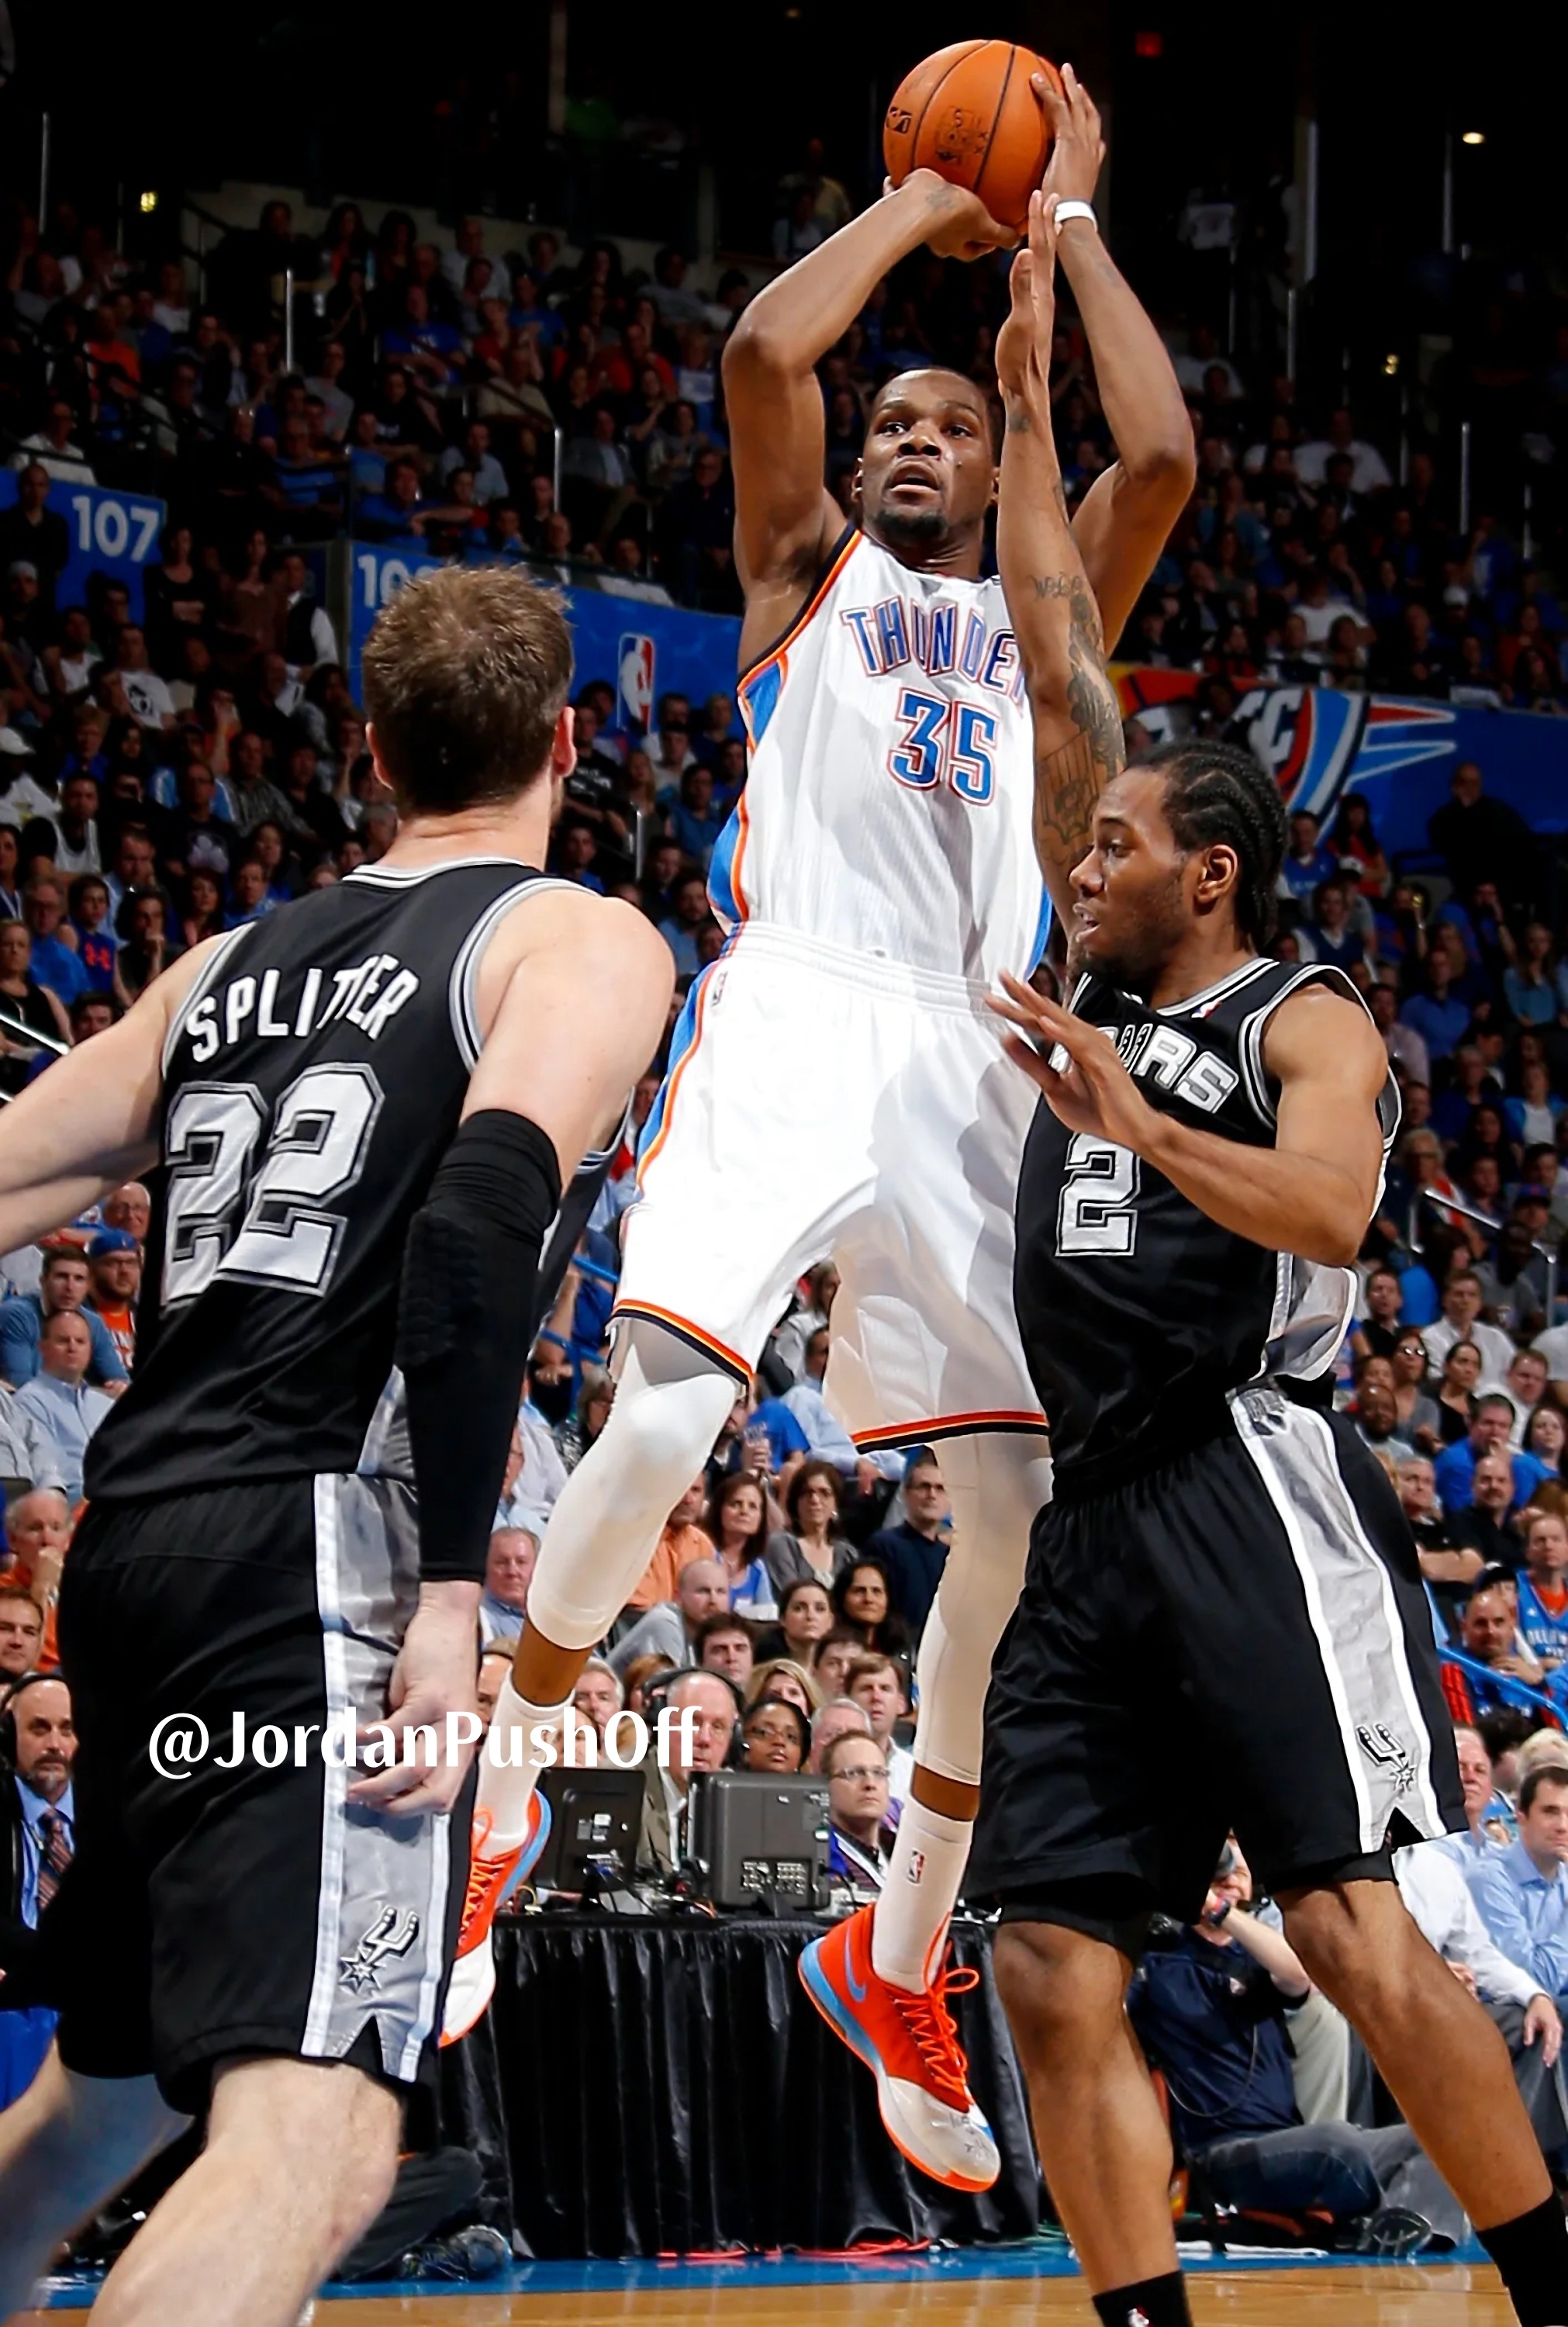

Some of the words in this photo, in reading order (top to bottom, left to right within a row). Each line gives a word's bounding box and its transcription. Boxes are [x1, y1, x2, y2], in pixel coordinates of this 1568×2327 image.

[71, 496, 159, 562] 107
[357, 554, 433, 609] 10
[886, 686, 1002, 807] 35
[186, 953, 420, 1063] SPLITTER
[160, 1062, 385, 1316] 22
[1055, 1131, 1141, 1257] 2
